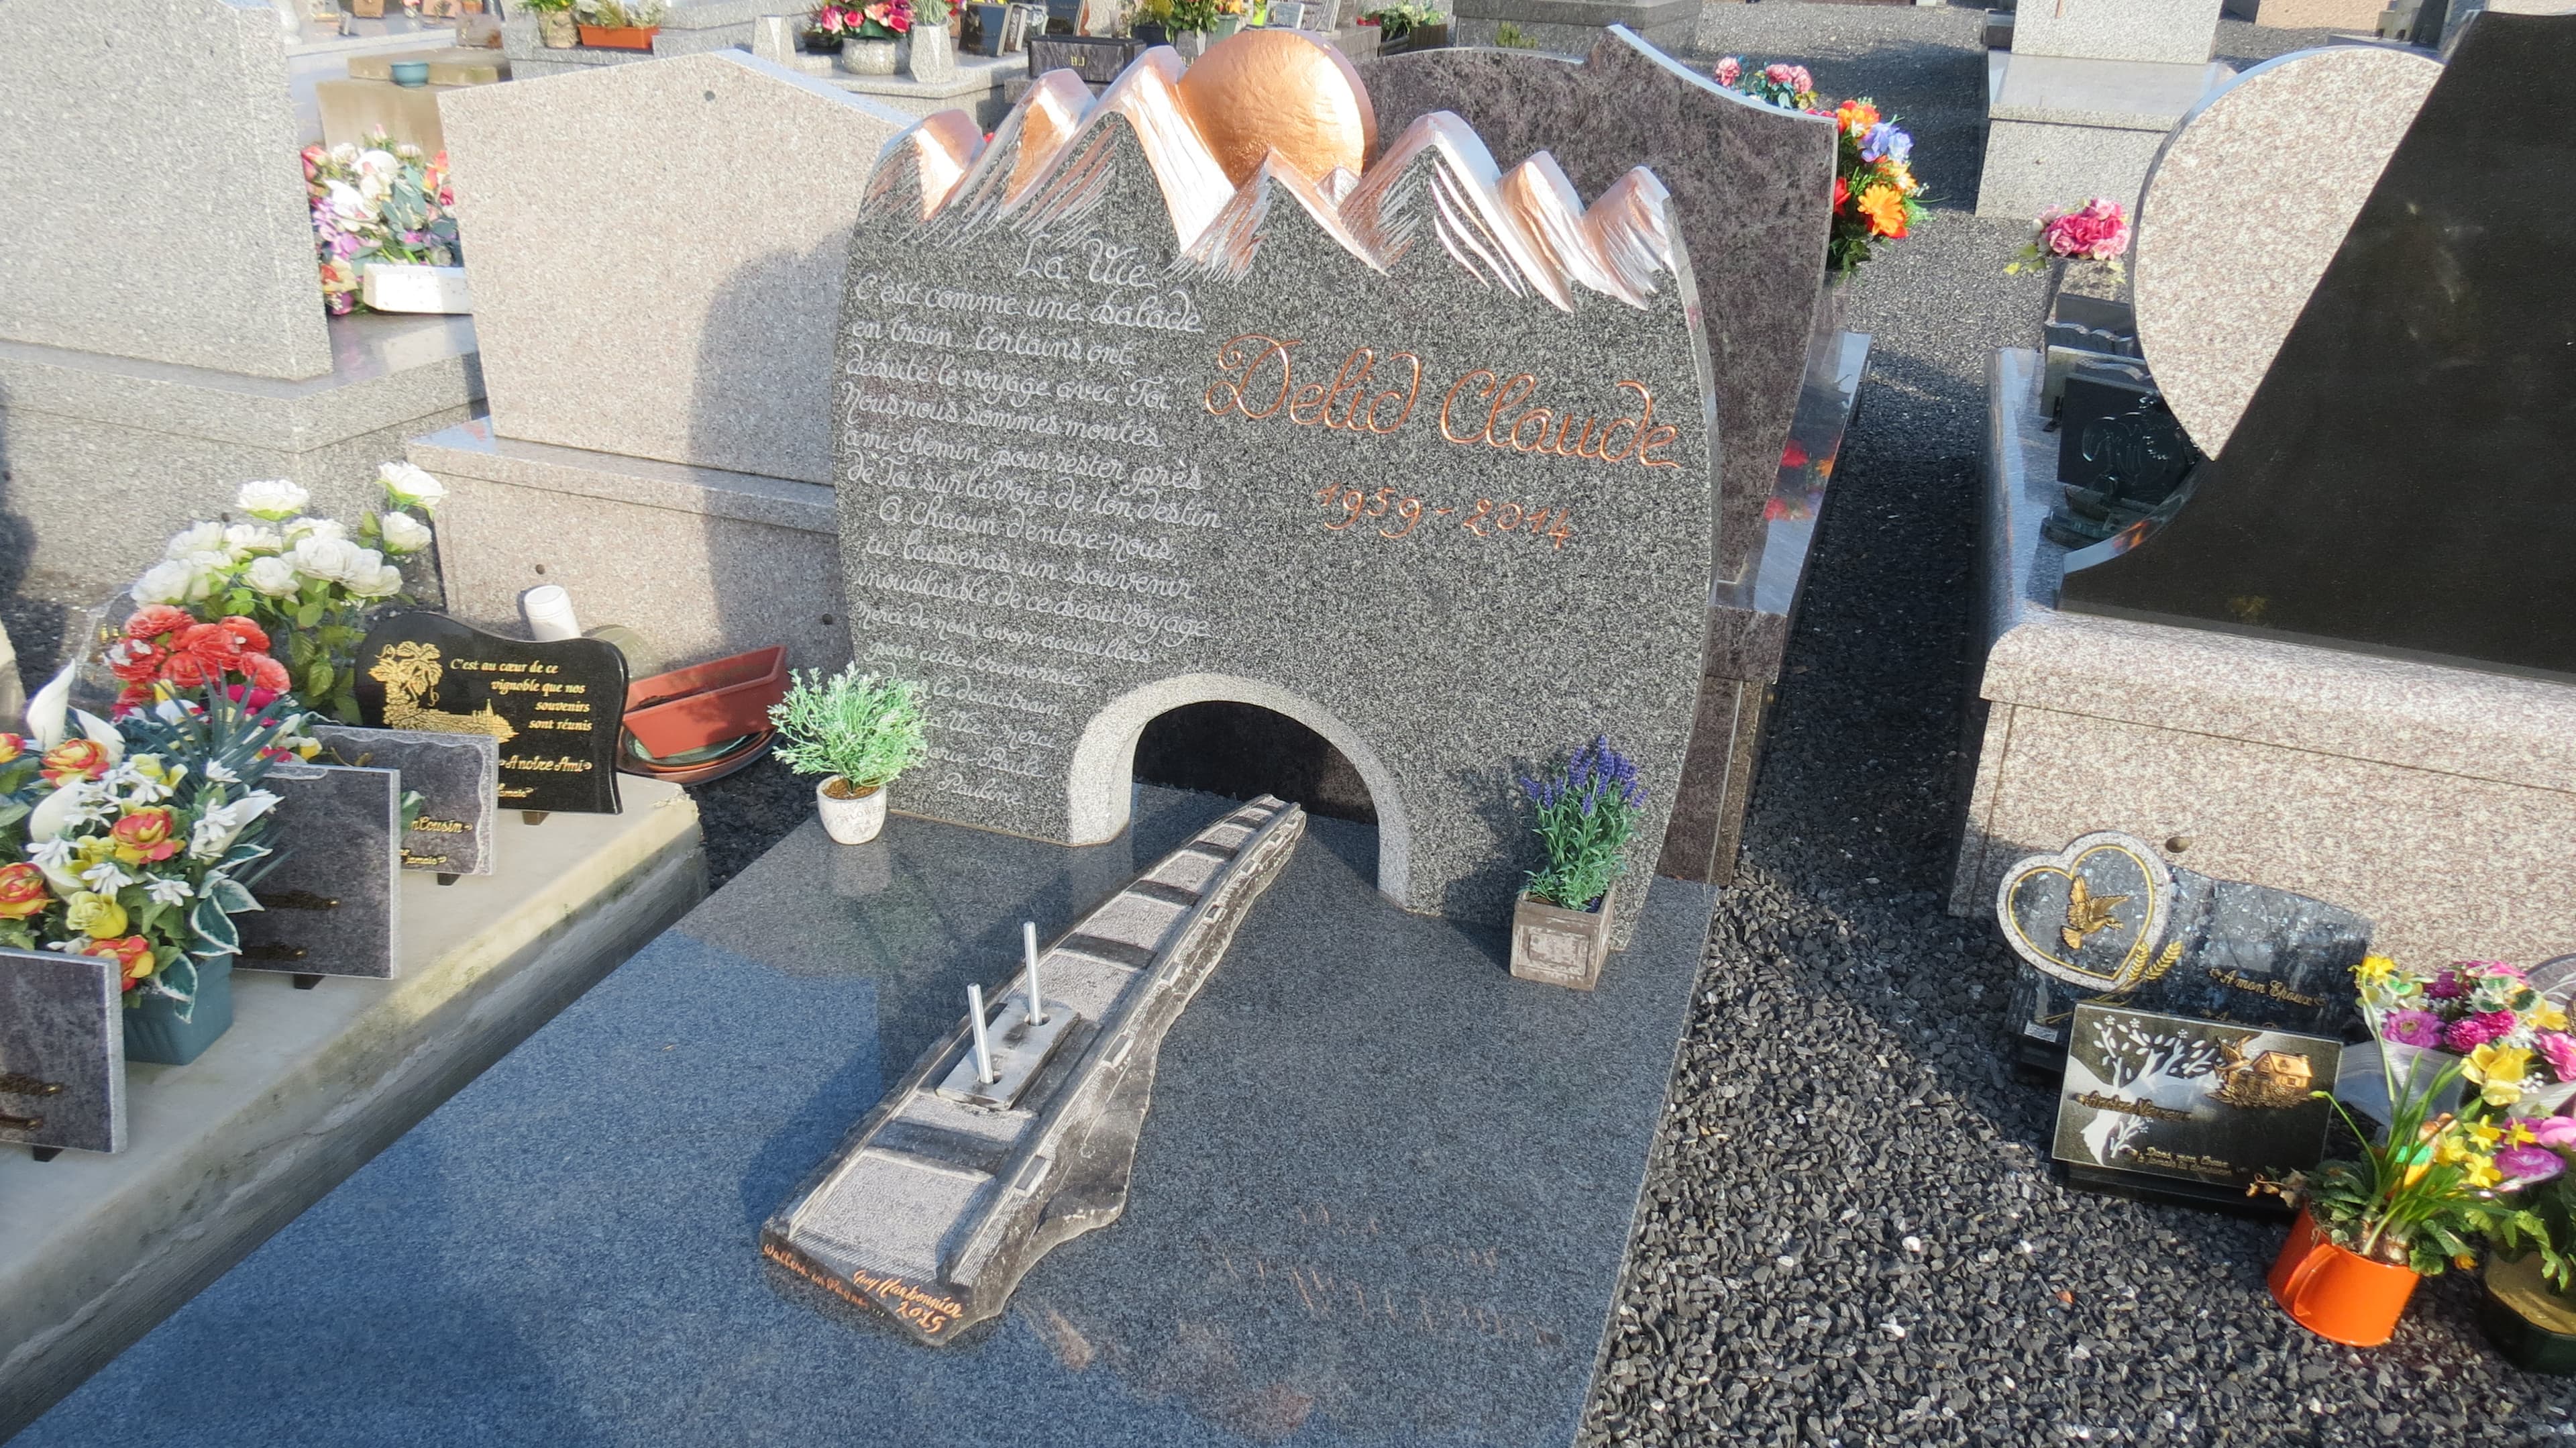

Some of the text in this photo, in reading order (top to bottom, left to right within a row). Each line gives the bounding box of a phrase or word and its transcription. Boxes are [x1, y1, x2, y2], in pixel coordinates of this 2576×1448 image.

[1016, 234, 1158, 289] La Vie
[856, 274, 920, 305] C'est
[925, 289, 1022, 315] comme
[1026, 297, 1085, 322] une
[853, 312, 1137, 366] en train Certains ont
[938, 354, 959, 387] le
[961, 368, 1051, 408] voyage
[1056, 381, 1120, 403] avec
[1205, 333, 1680, 469] Delid Claude
[902, 399, 959, 423] nous
[961, 403, 1062, 435] sommes
[1064, 416, 1167, 448] montés
[843, 450, 874, 484] de
[920, 470, 962, 495] sur
[966, 466, 991, 499] la
[1055, 476, 1085, 511] de
[1089, 486, 1136, 518] ton
[1137, 487, 1223, 529] destin
[983, 450, 1052, 477] pour
[1054, 452, 1125, 480] rester
[1119, 453, 1205, 497] près
[1316, 482, 1421, 539] 1959
[1462, 499, 1574, 550] 2014
[867, 534, 896, 557] tu
[904, 528, 1012, 572] laisseras
[1021, 561, 1059, 581] un
[855, 567, 989, 605] inoubliable
[994, 574, 1024, 609] de
[1026, 596, 1052, 613] ce
[1053, 587, 1122, 624] beau
[863, 642, 914, 663] pour
[919, 645, 968, 667] cette
[908, 603, 930, 629] de
[933, 618, 979, 641] nous
[982, 625, 1039, 645] avoir
[1041, 635, 1154, 663] accueillies
[450, 658, 480, 670] C'est
[481, 663, 497, 672] au
[529, 660, 543, 674] de
[545, 664, 559, 674] ce
[490, 678, 586, 697] vignoble que nos
[535, 701, 590, 713] souvenirs
[932, 675, 953, 696] le
[955, 674, 1003, 707] doux
[1005, 691, 1063, 717] train
[528, 718, 593, 731] sont réunis
[519, 756, 554, 771] notre
[553, 756, 585, 772] Ami
[920, 746, 1047, 778] arie-Paule
[936, 772, 1024, 805] Pauline
[419, 816, 464, 833] Cousin
[2220, 970, 2313, 1006] A mon Epoux
[853, 1269, 880, 1293] Guy
[896, 1300, 947, 1335] 2015
